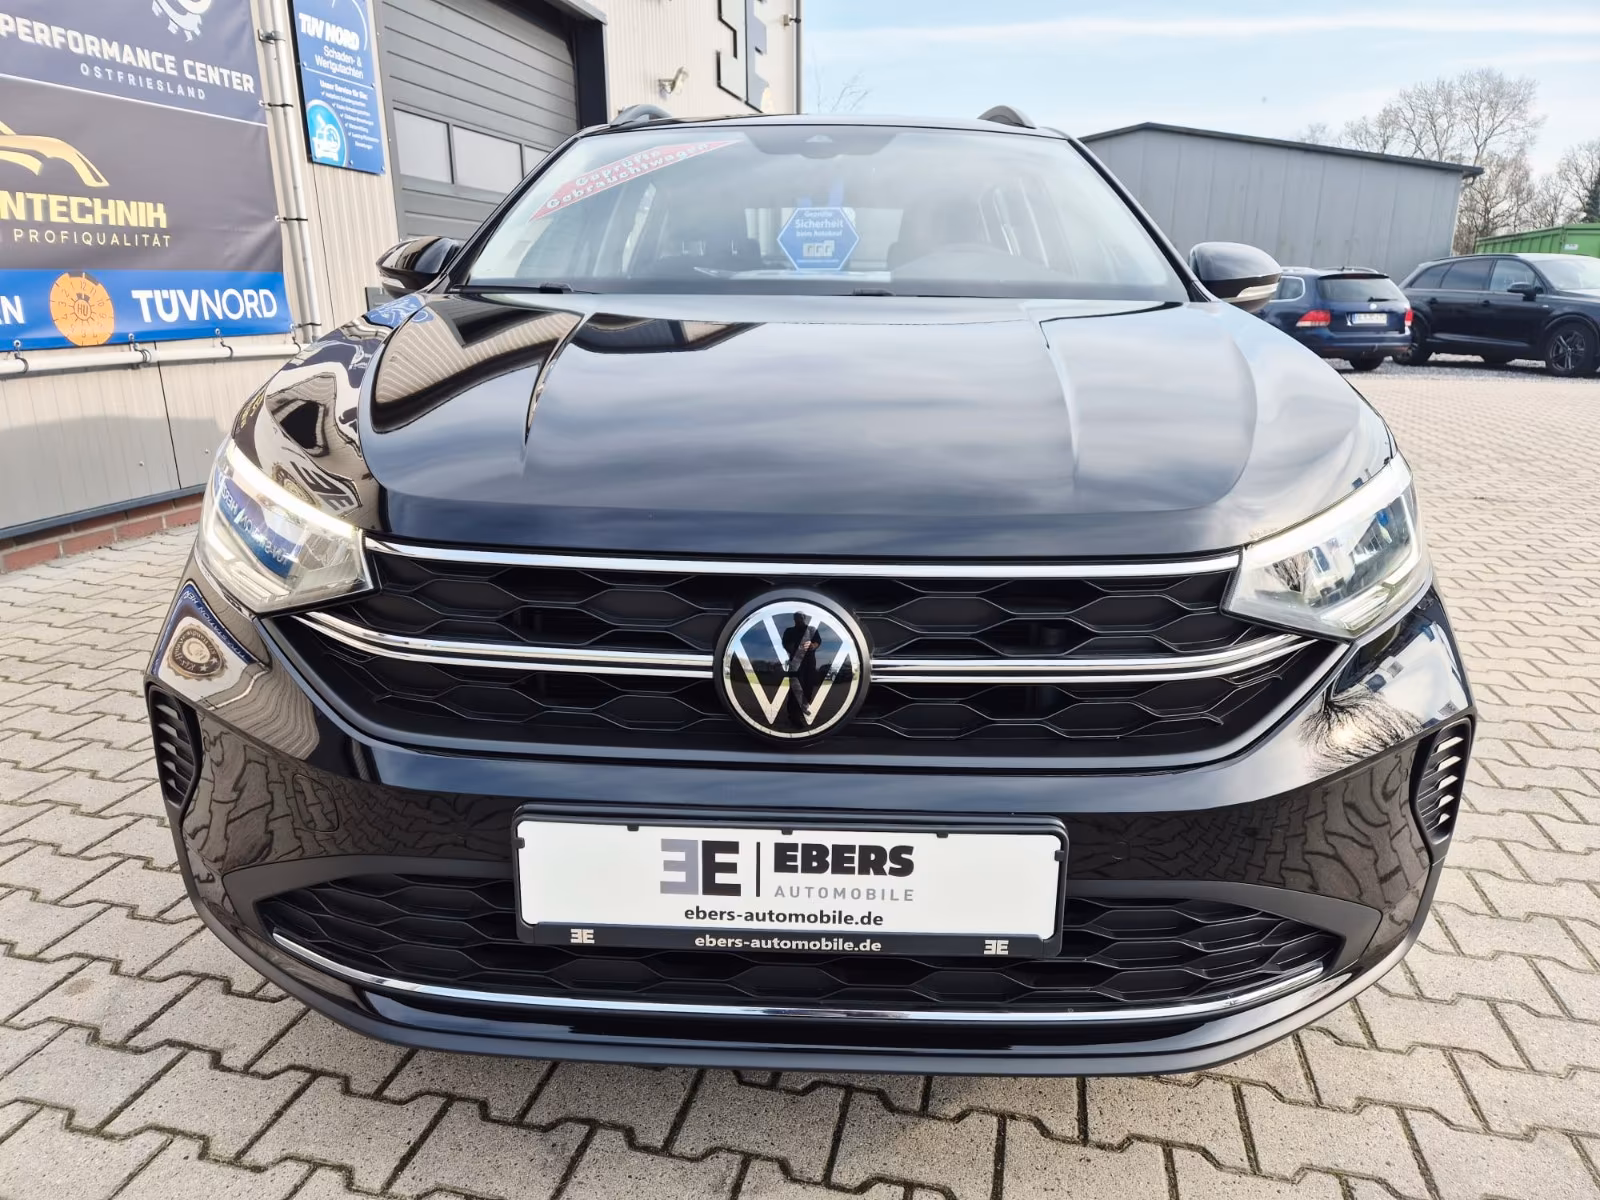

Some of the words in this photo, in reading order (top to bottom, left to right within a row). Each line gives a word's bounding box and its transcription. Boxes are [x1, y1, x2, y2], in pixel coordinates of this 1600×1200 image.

[299, 12, 324, 39] TÜV
[325, 22, 360, 51] NORD
[0, 12, 178, 76] PERFORMANCE
[183, 59, 256, 94] CENTER
[80, 62, 206, 100] OSTFRIESLAND
[795, 219, 844, 229] Sicherheit
[0, 295, 25, 325] N
[774, 842, 915, 878] EBERS
[774, 885, 914, 902] AUTOMOBILE
[684, 905, 884, 926] ebers-automobile.de
[694, 934, 882, 952] ebers-automobile.de
